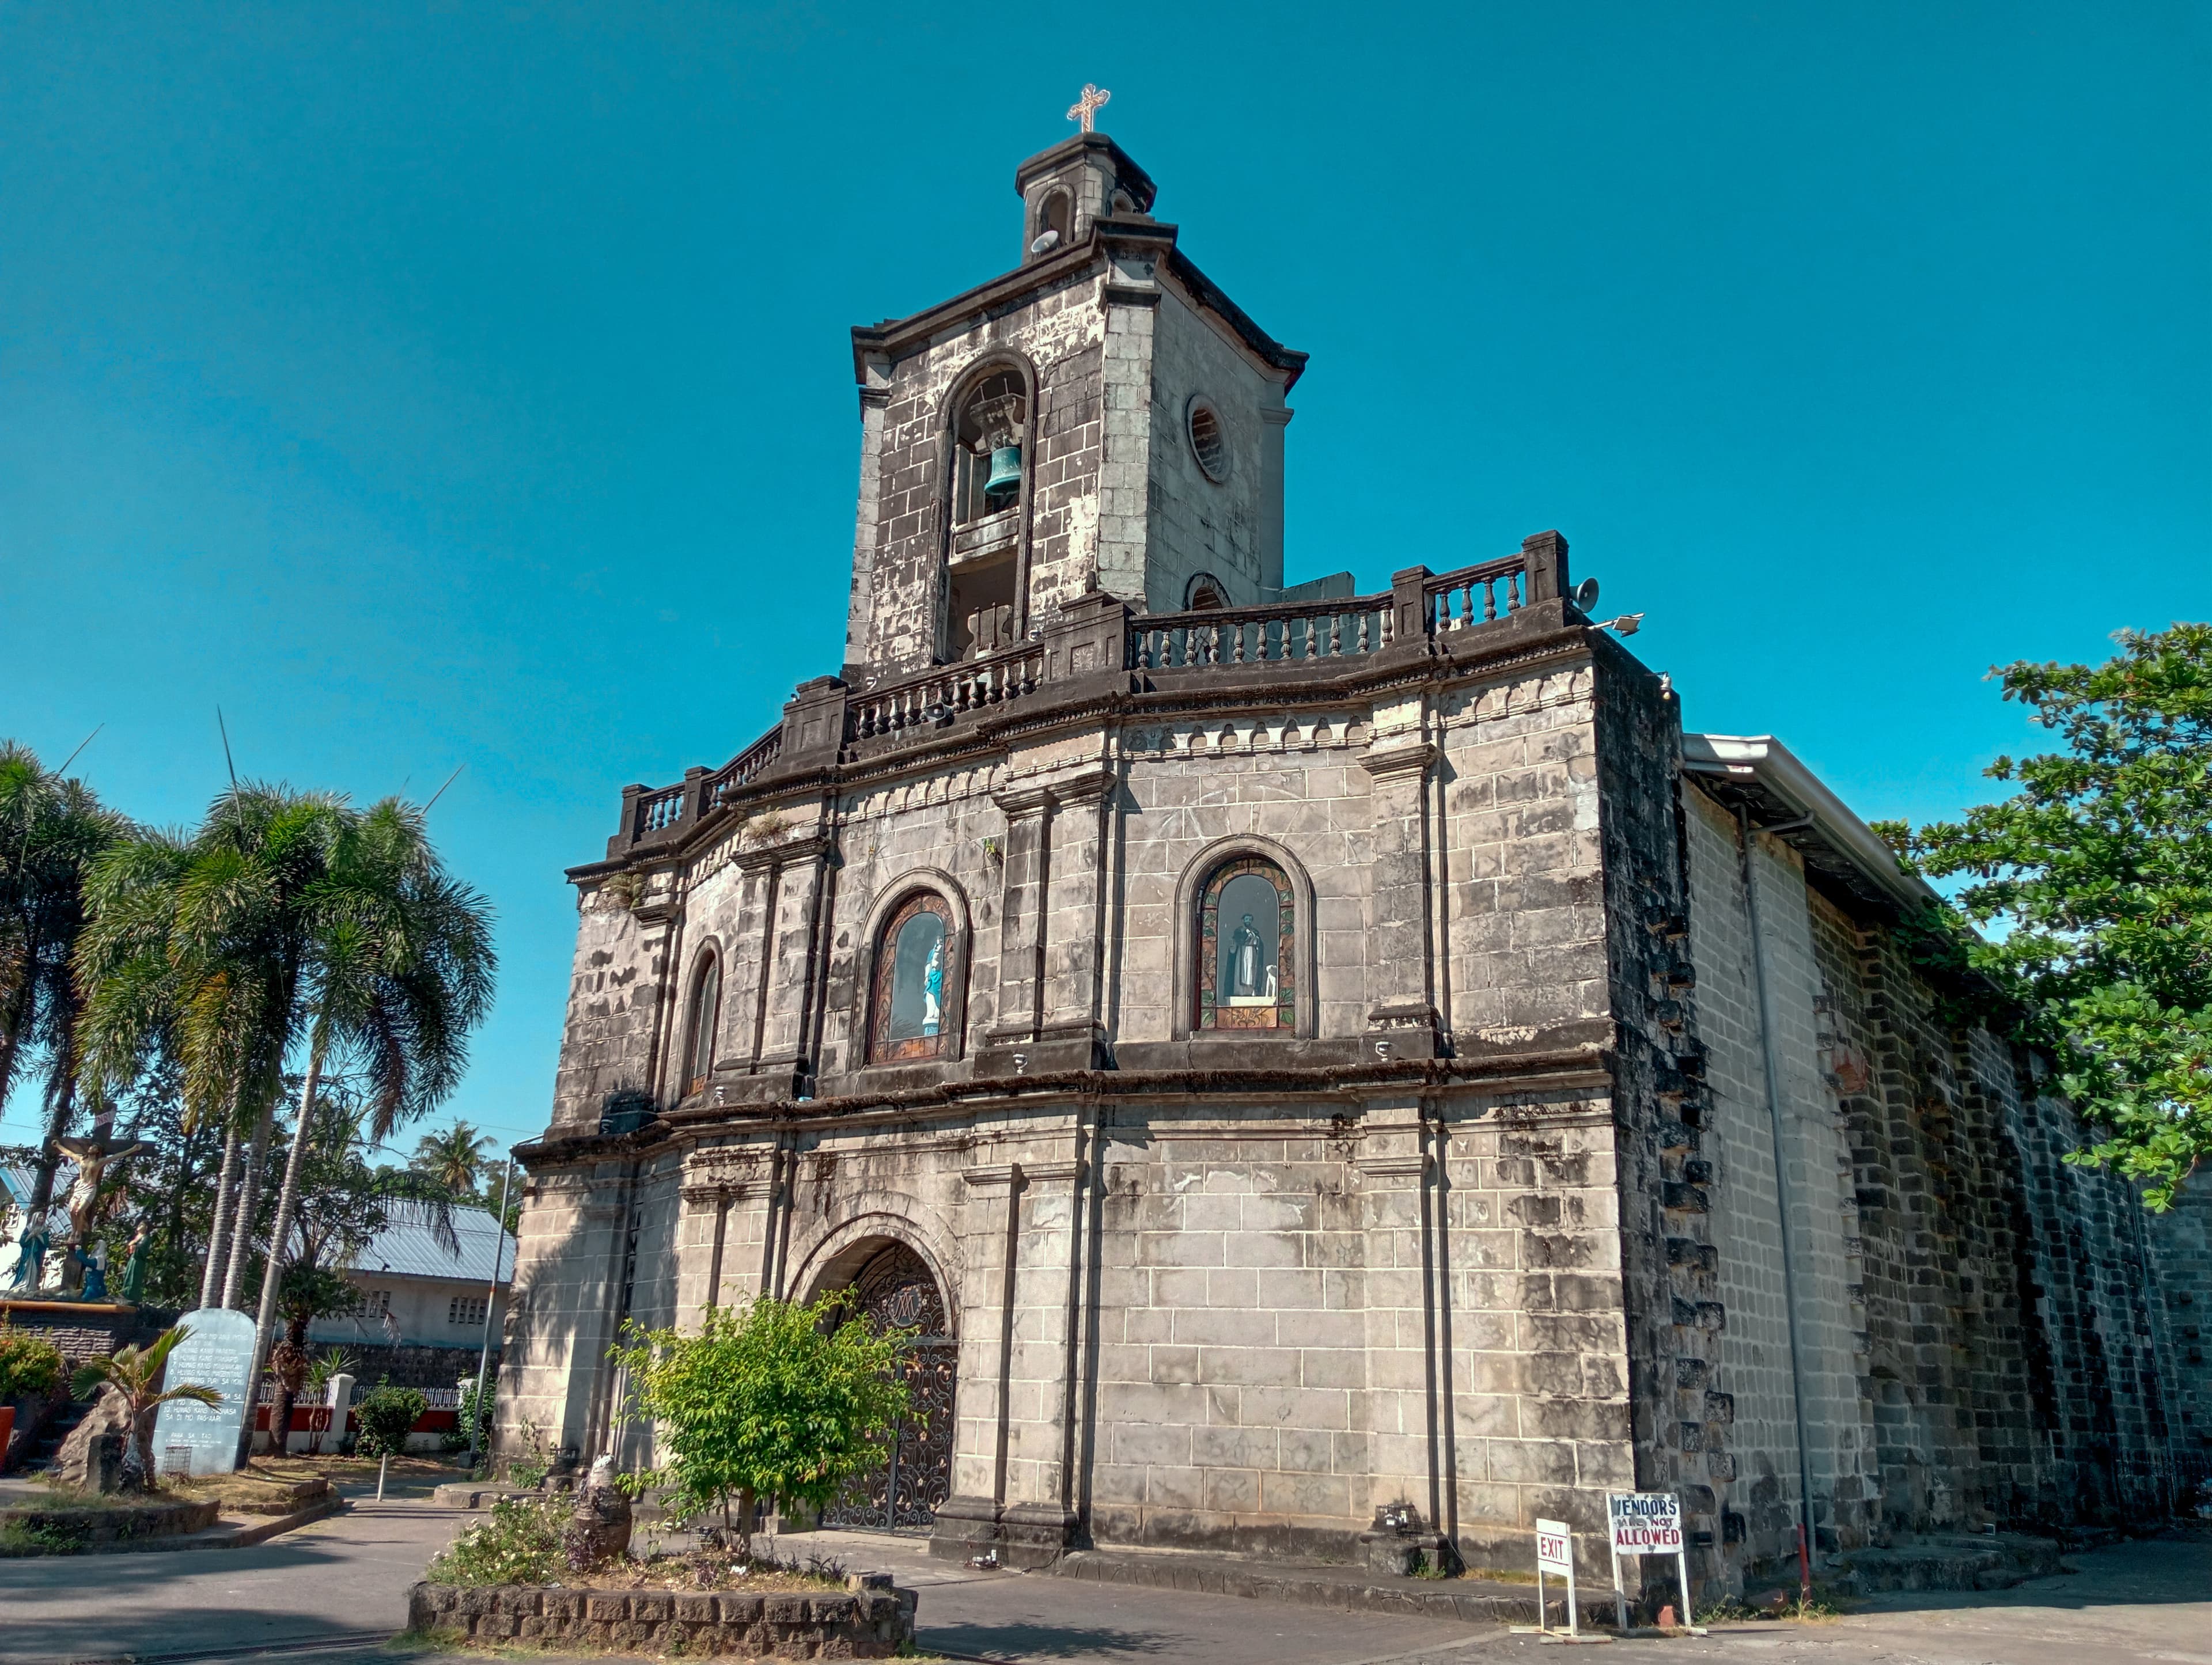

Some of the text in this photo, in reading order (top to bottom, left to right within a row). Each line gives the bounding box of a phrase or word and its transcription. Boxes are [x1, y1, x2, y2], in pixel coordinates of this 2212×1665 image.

[1651, 1518, 1674, 1526] NOT
[1617, 1529, 1680, 1545] ALLOWED
[1541, 1536, 1563, 1560] EXIT
